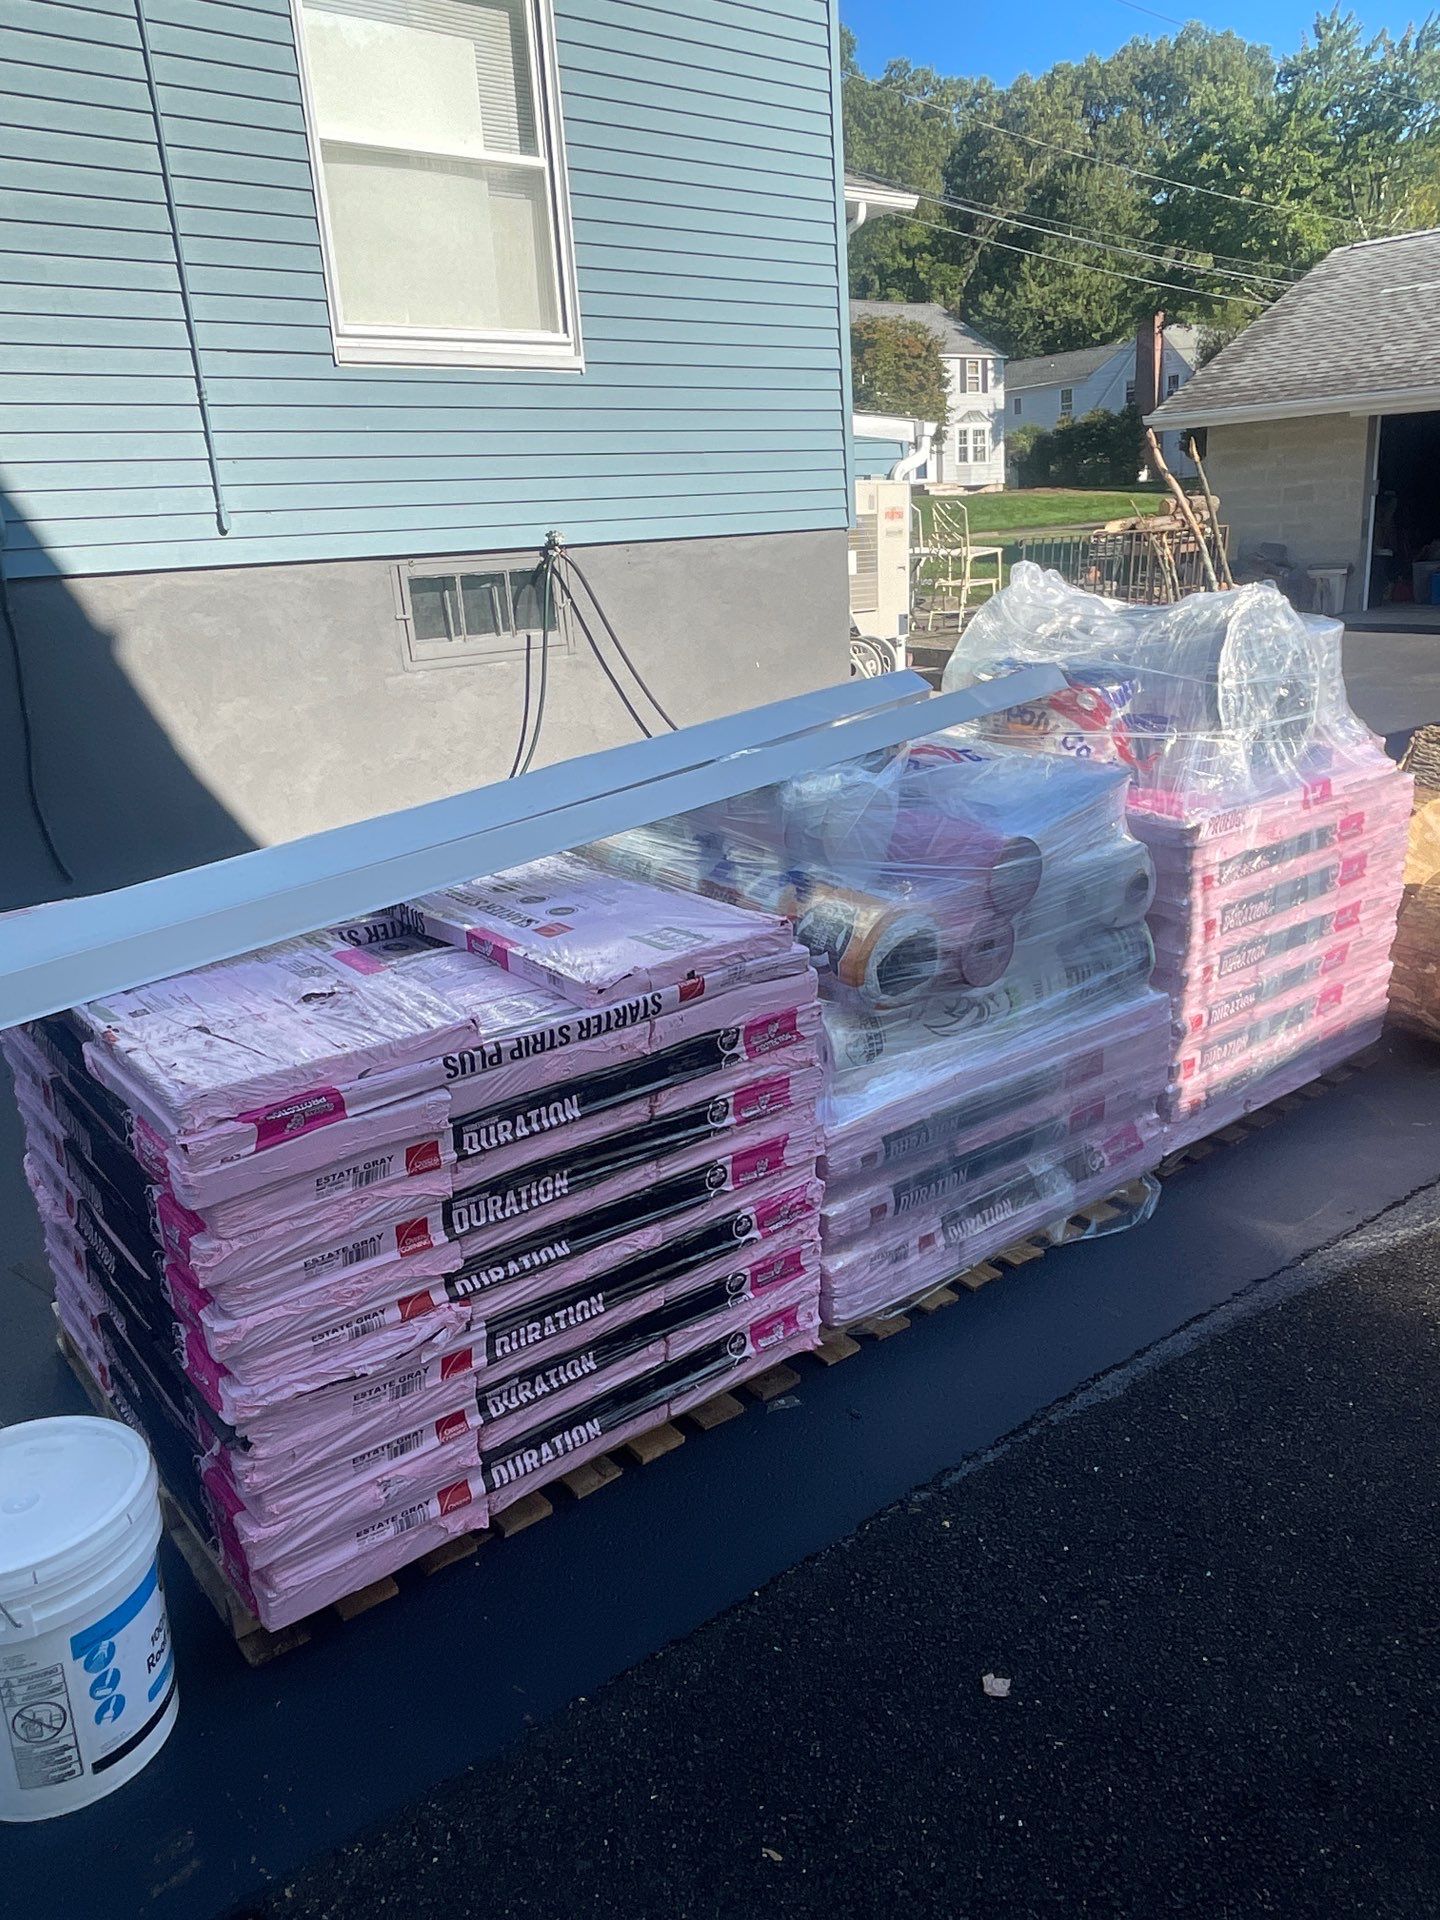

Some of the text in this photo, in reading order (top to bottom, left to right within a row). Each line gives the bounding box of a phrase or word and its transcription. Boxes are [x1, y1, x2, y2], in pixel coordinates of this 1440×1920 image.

[442, 992, 663, 1079] STARTER STRIP PLUS
[463, 1095, 581, 1154] DURATION
[316, 1155, 394, 1187] ESTATE GRAY
[900, 1162, 969, 1211] DURATION
[452, 1170, 569, 1234] DURATION
[948, 1198, 1014, 1243] DURATION
[304, 1245, 350, 1268] ESTATE
[352, 1233, 384, 1250] GRAY
[311, 1308, 386, 1343] ESTATE GRAY
[495, 1293, 605, 1357] DURATION
[353, 1380, 396, 1401] ESTATE
[398, 1366, 430, 1383] GRAY
[487, 1351, 598, 1418] DURATION
[352, 1429, 425, 1465] ESTATE GRAY
[491, 1418, 602, 1488] DURATION
[356, 1499, 431, 1538] ESTATE GRAY
